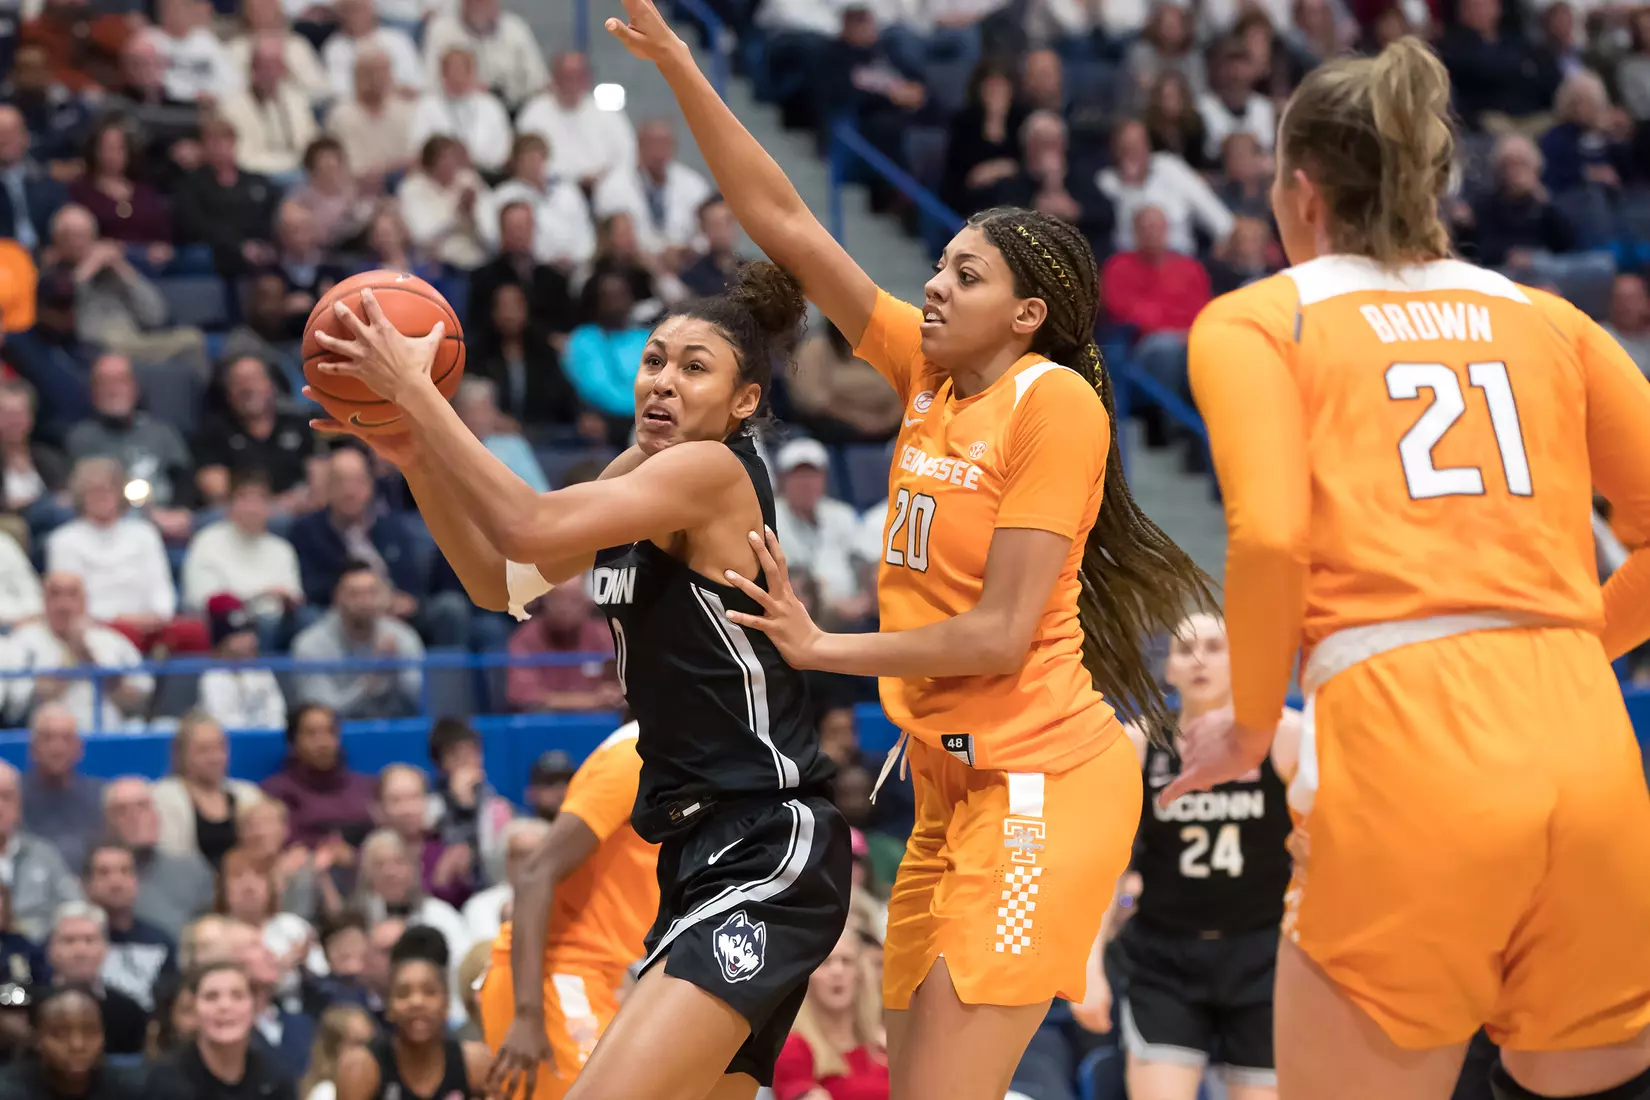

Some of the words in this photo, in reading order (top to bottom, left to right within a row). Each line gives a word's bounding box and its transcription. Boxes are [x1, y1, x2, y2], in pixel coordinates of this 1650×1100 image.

[1360, 301, 1492, 343] BROWN
[1384, 360, 1534, 500] 21
[885, 487, 937, 574] 20
[947, 738, 963, 748] 48
[1178, 823, 1244, 877] 24
